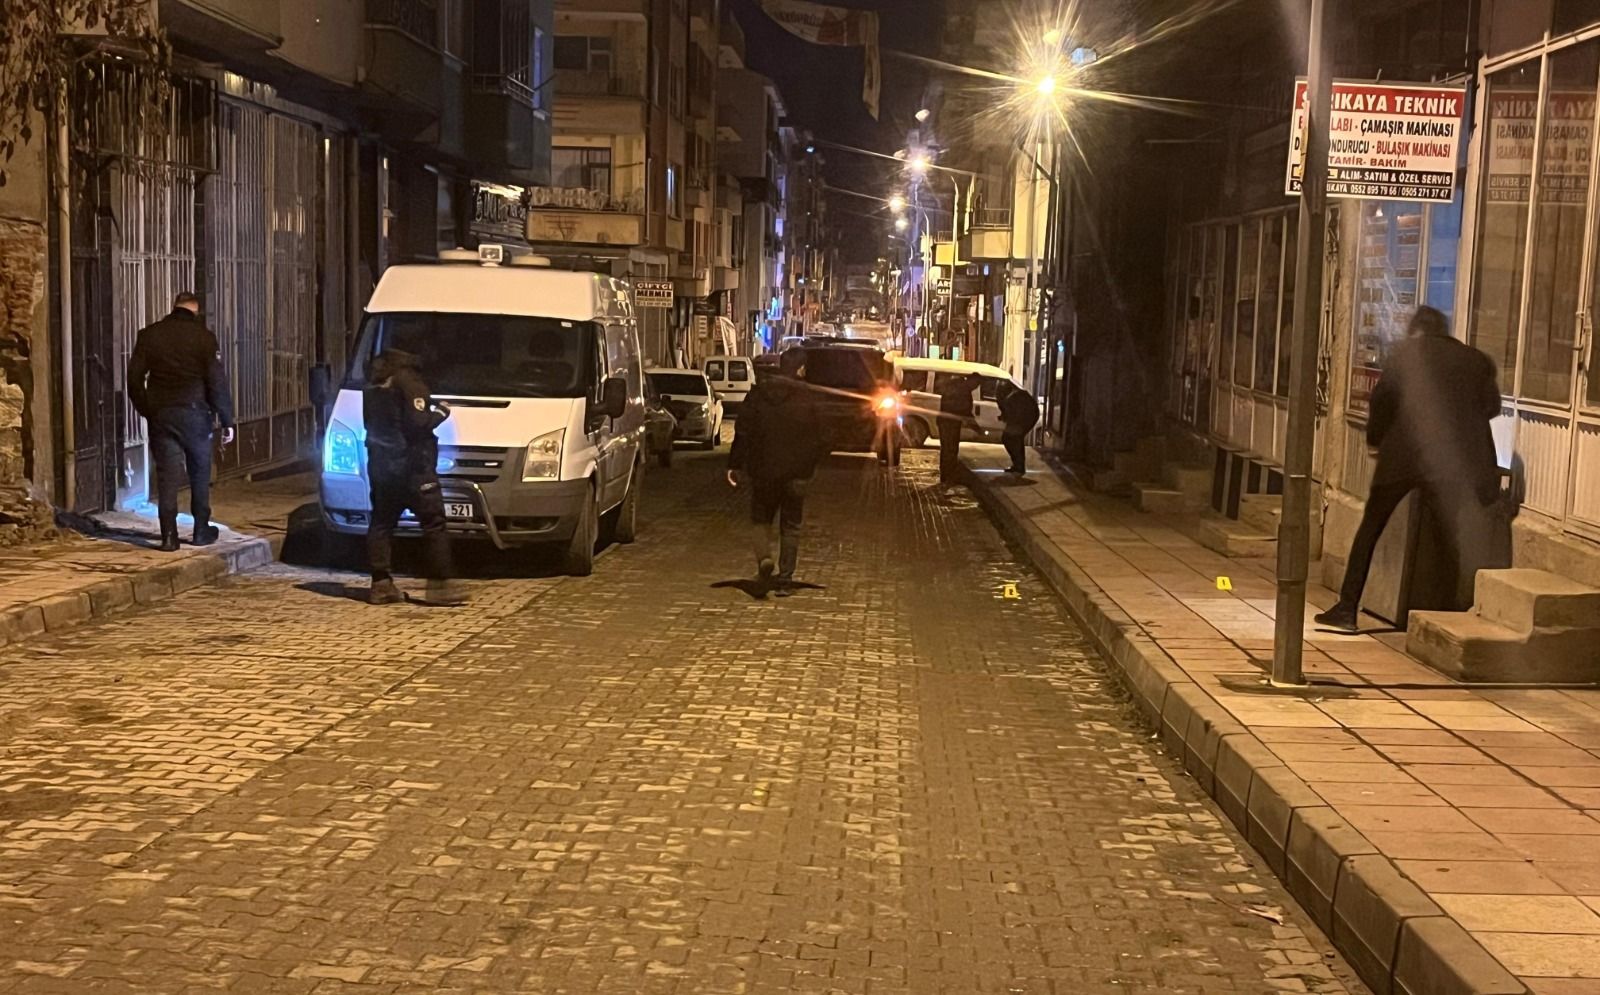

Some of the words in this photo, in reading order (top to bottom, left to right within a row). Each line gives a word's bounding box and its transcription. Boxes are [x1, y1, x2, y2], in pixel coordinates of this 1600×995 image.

[1302, 91, 1388, 112] SIKAYA
[1394, 93, 1457, 115] TEKNİK
[1360, 119, 1404, 138] ÇAMAŞIR
[1406, 119, 1454, 137] MAKİNASI
[1376, 140, 1411, 159] BULAŞIK
[1412, 140, 1451, 158] MAKİNASI
[1370, 158, 1407, 168] BAKIM
[1364, 171, 1389, 182] SATIM
[1399, 172, 1419, 183] ÖZEL
[1422, 174, 1451, 185] SERVİS
[451, 504, 470, 516] 521
